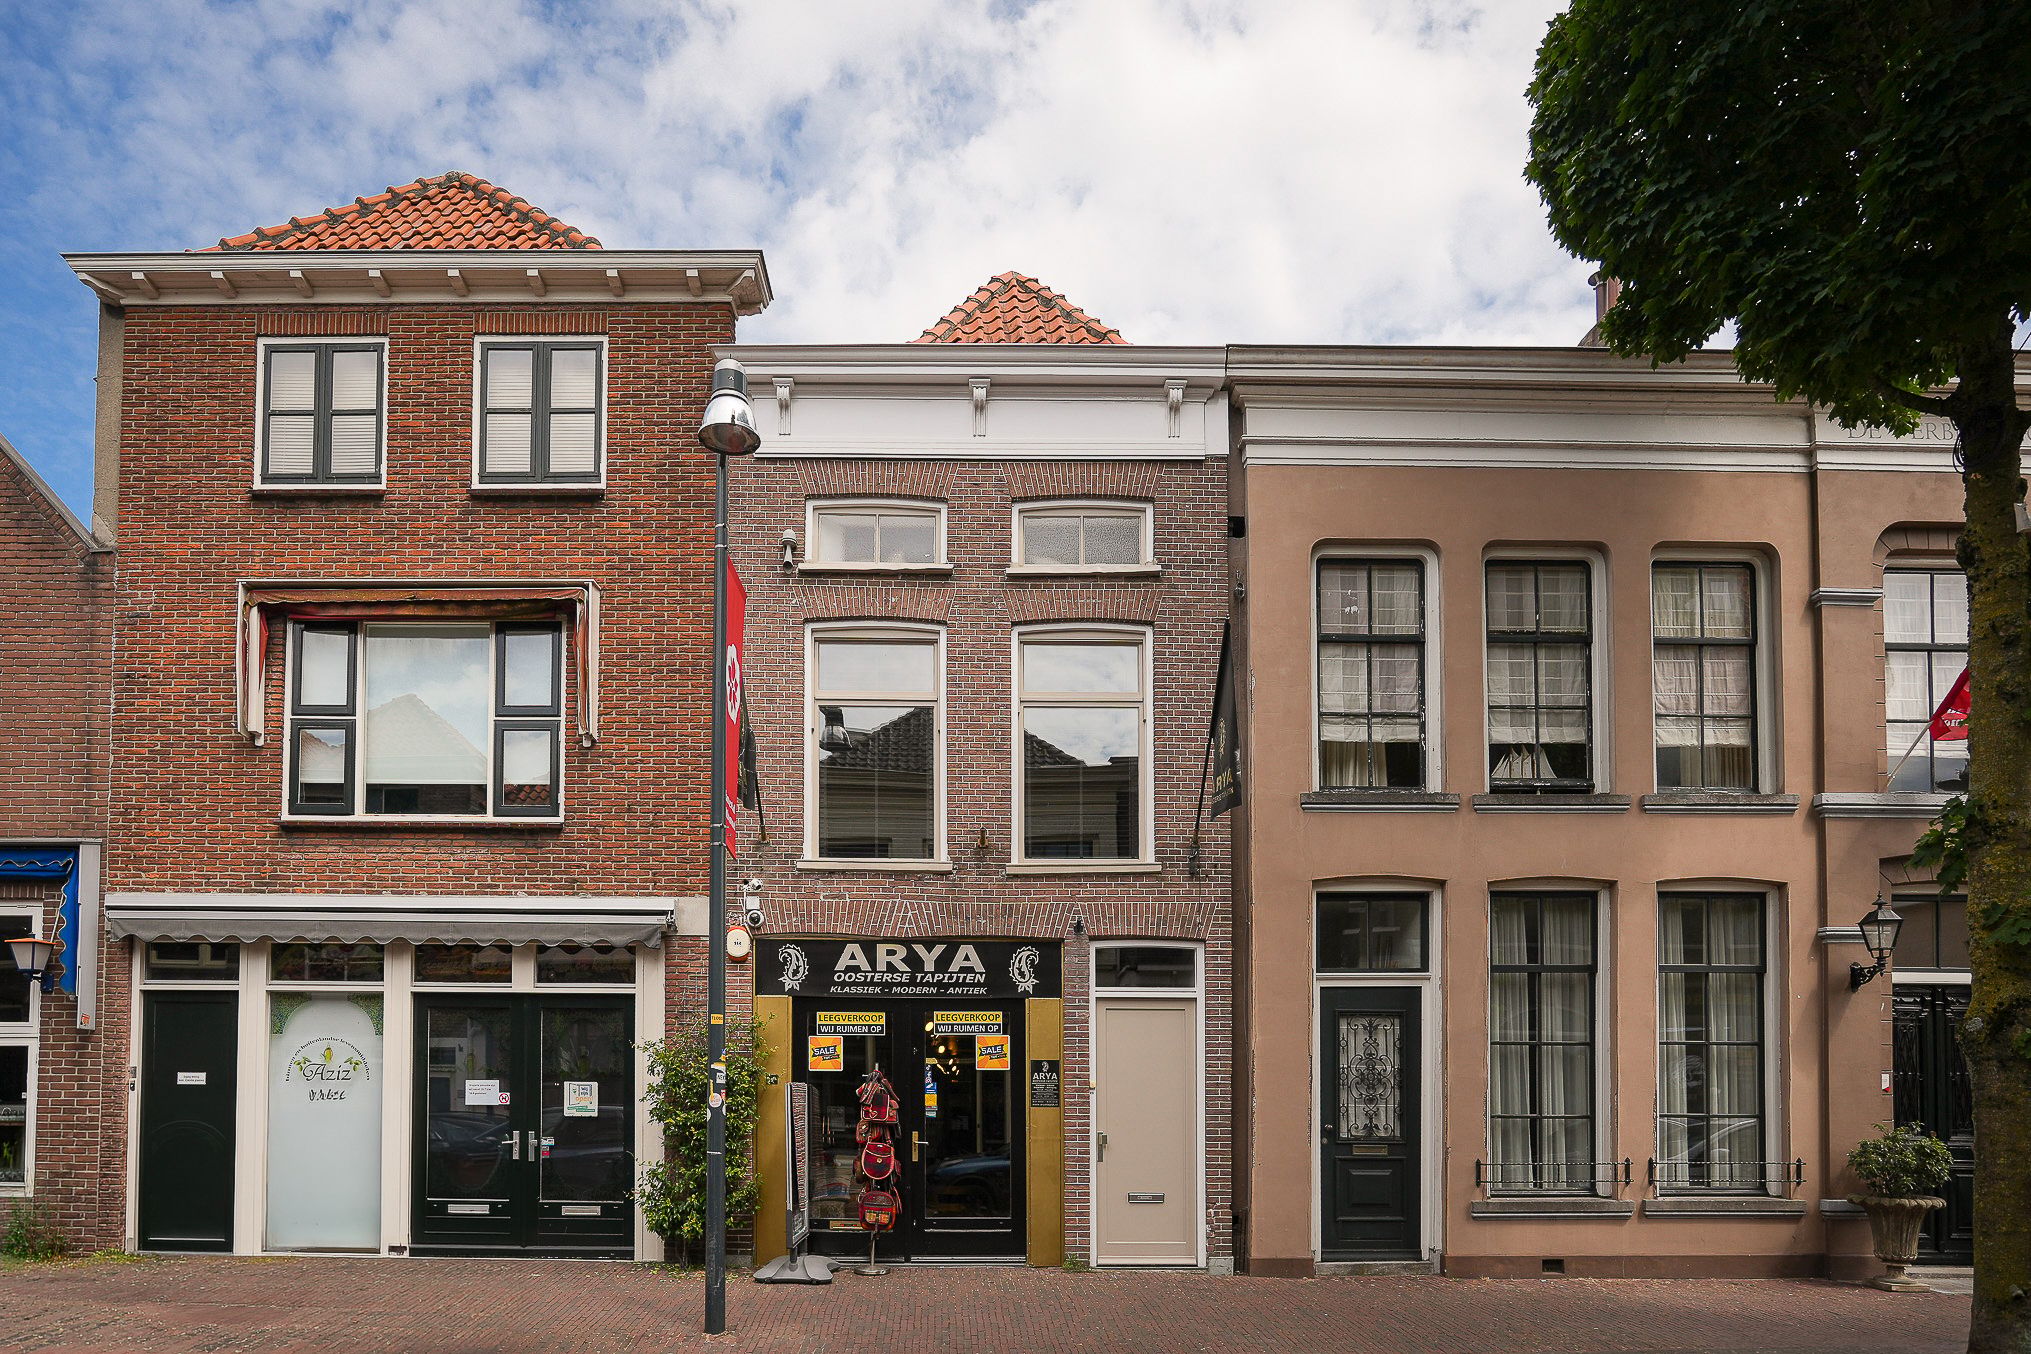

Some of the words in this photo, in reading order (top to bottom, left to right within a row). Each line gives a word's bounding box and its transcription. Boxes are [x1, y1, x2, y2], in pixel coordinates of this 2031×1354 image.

[834, 943, 986, 972] ARYA
[833, 972, 911, 983] OOSTERSE
[915, 973, 986, 983] TAPIJTEN
[829, 985, 882, 994] KLASSIEK
[891, 986, 937, 994] MODERN
[947, 987, 988, 995] ANTIEK
[818, 1014, 884, 1022] LEEGVERKOOP
[936, 1013, 1001, 1022] LEEGVERKOOP
[820, 1025, 835, 1033] WIJ
[836, 1025, 868, 1033] RUIMEN
[870, 1025, 882, 1033] OP
[937, 1024, 952, 1032] WIJ
[953, 1024, 986, 1032] RUIMEN
[987, 1024, 999, 1032] OP
[814, 1046, 835, 1056] SALE
[981, 1045, 1002, 1055] SALE
[302, 1063, 352, 1082] Aziz
[1032, 1072, 1058, 1080] ARYA
